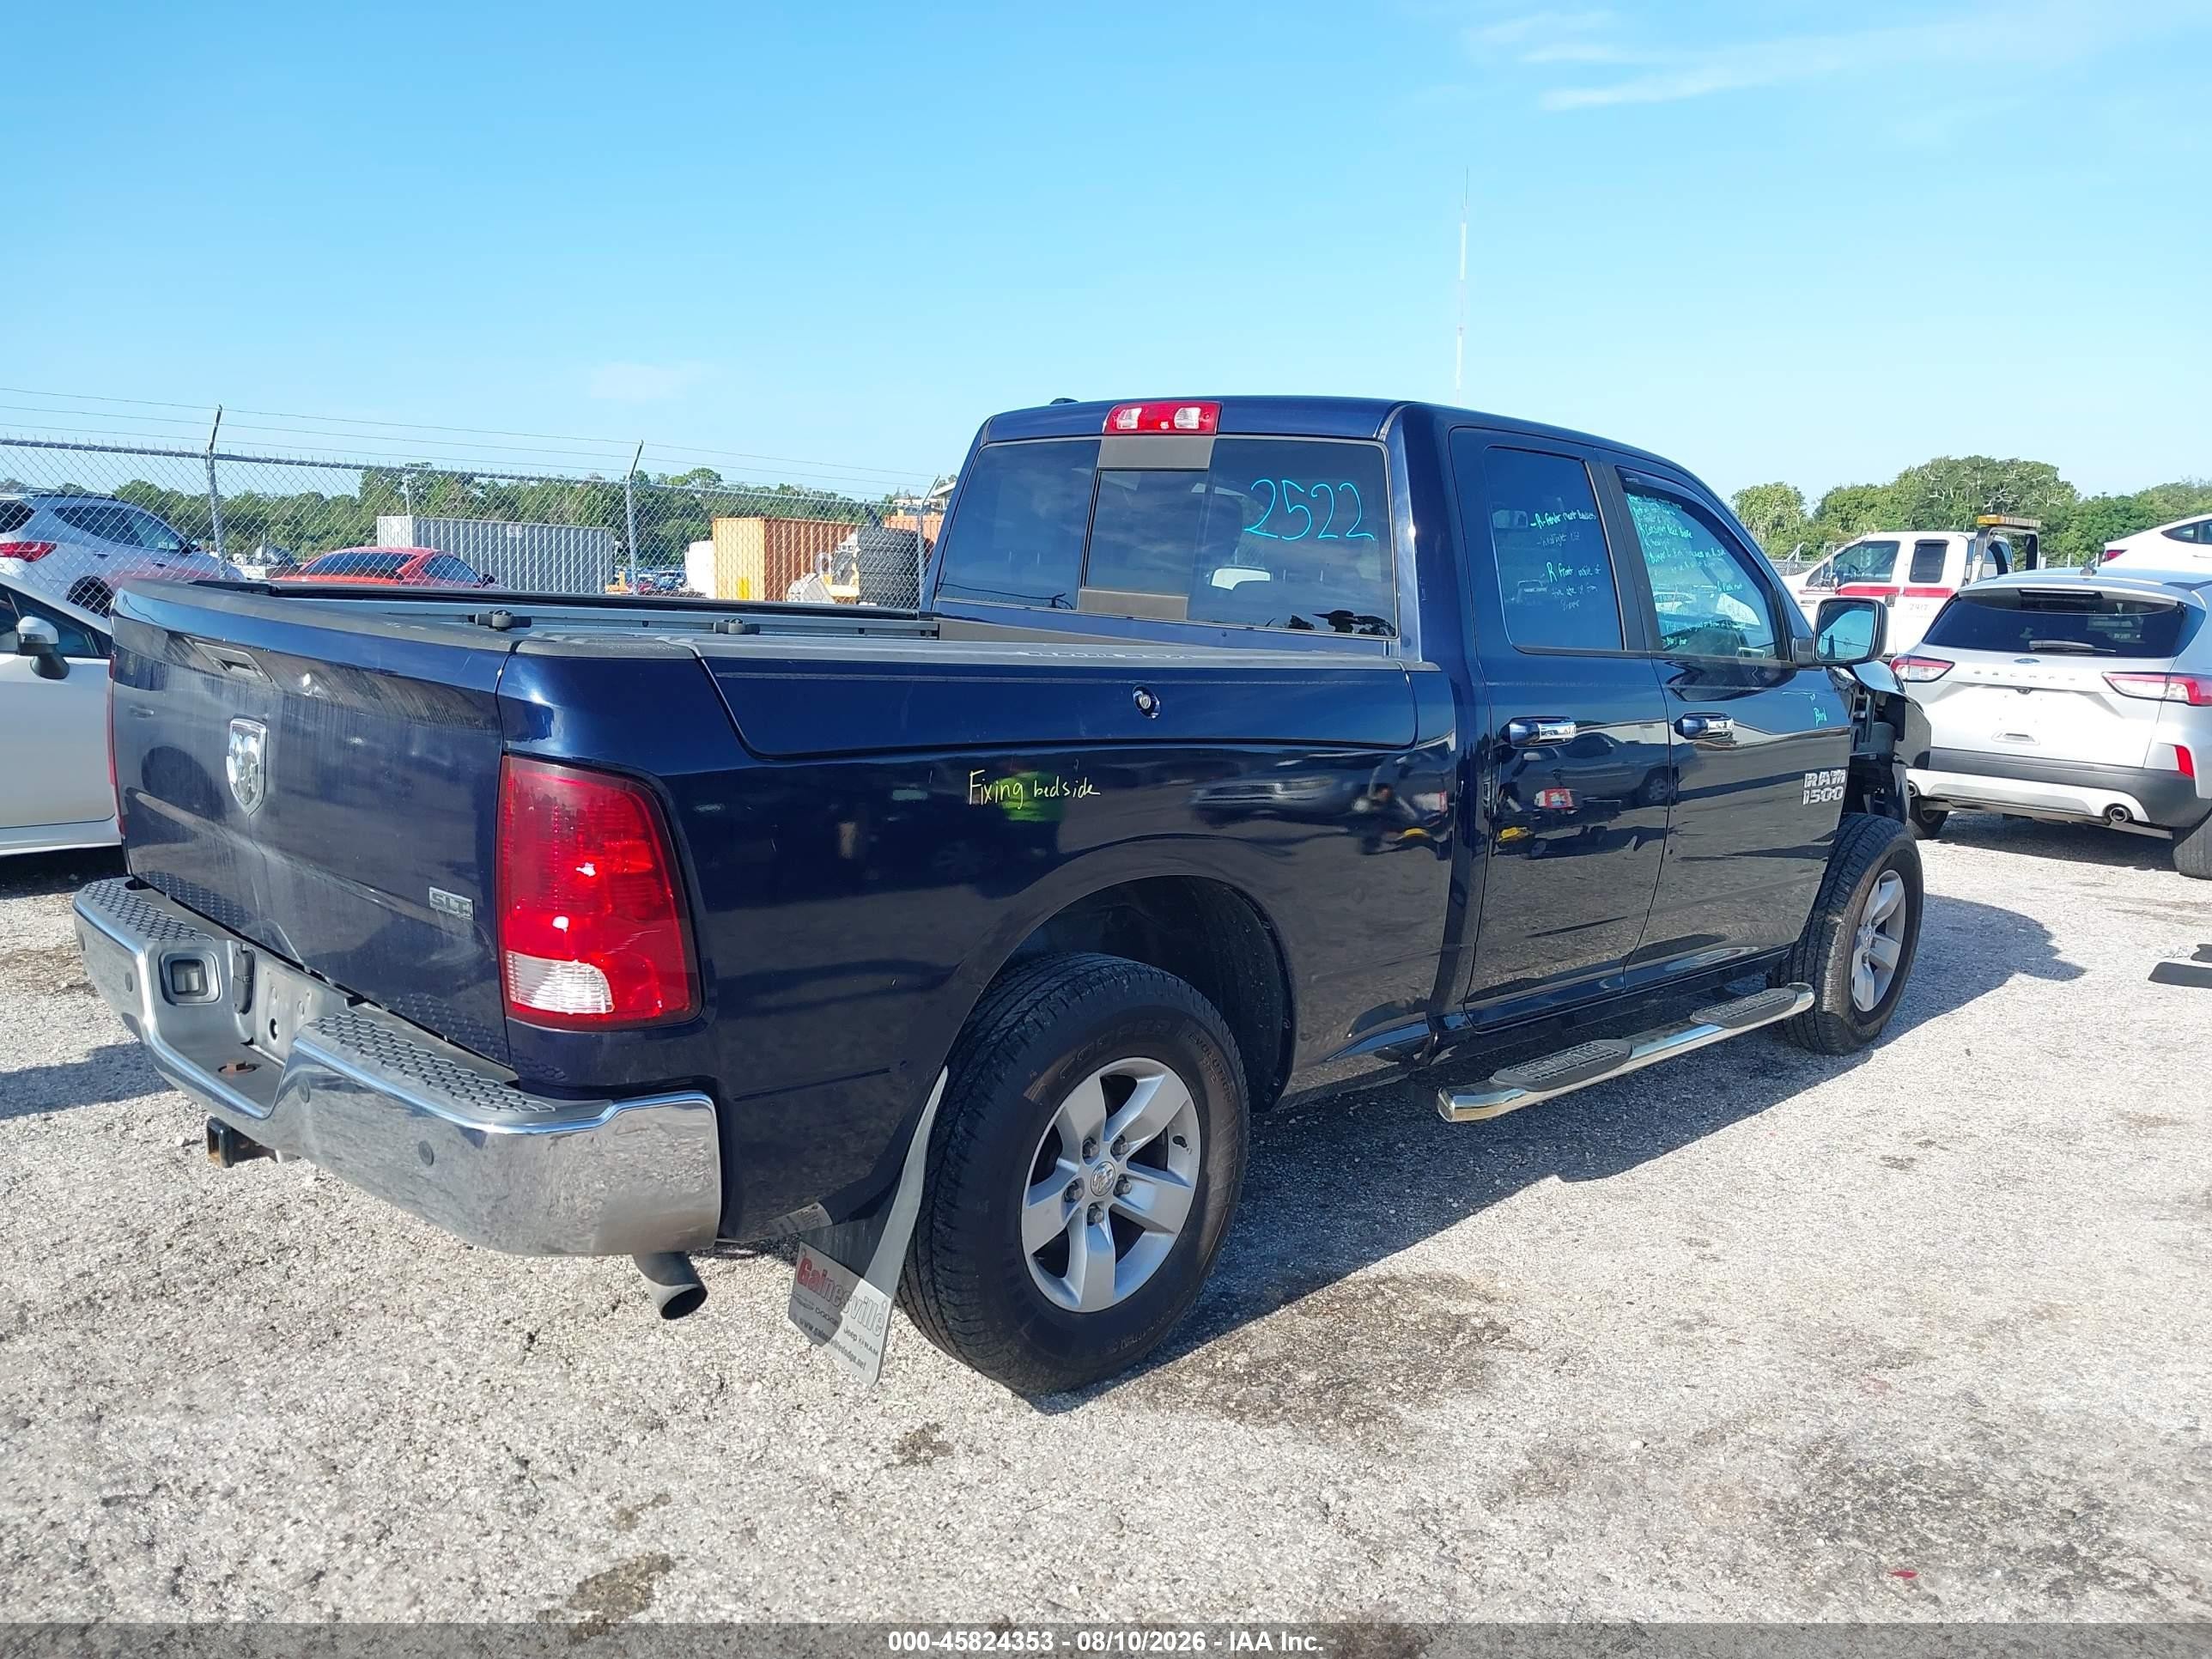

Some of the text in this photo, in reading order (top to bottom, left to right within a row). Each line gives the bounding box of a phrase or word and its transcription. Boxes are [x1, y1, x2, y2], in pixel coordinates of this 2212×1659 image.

[1243, 478, 1376, 541] 2522
[968, 769, 1102, 811] Fixing bedside
[1803, 769, 1847, 789] RAM
[1802, 786, 1844, 806] 1500
[431, 892, 469, 915] SLT
[797, 1257, 885, 1337] Gainesville
